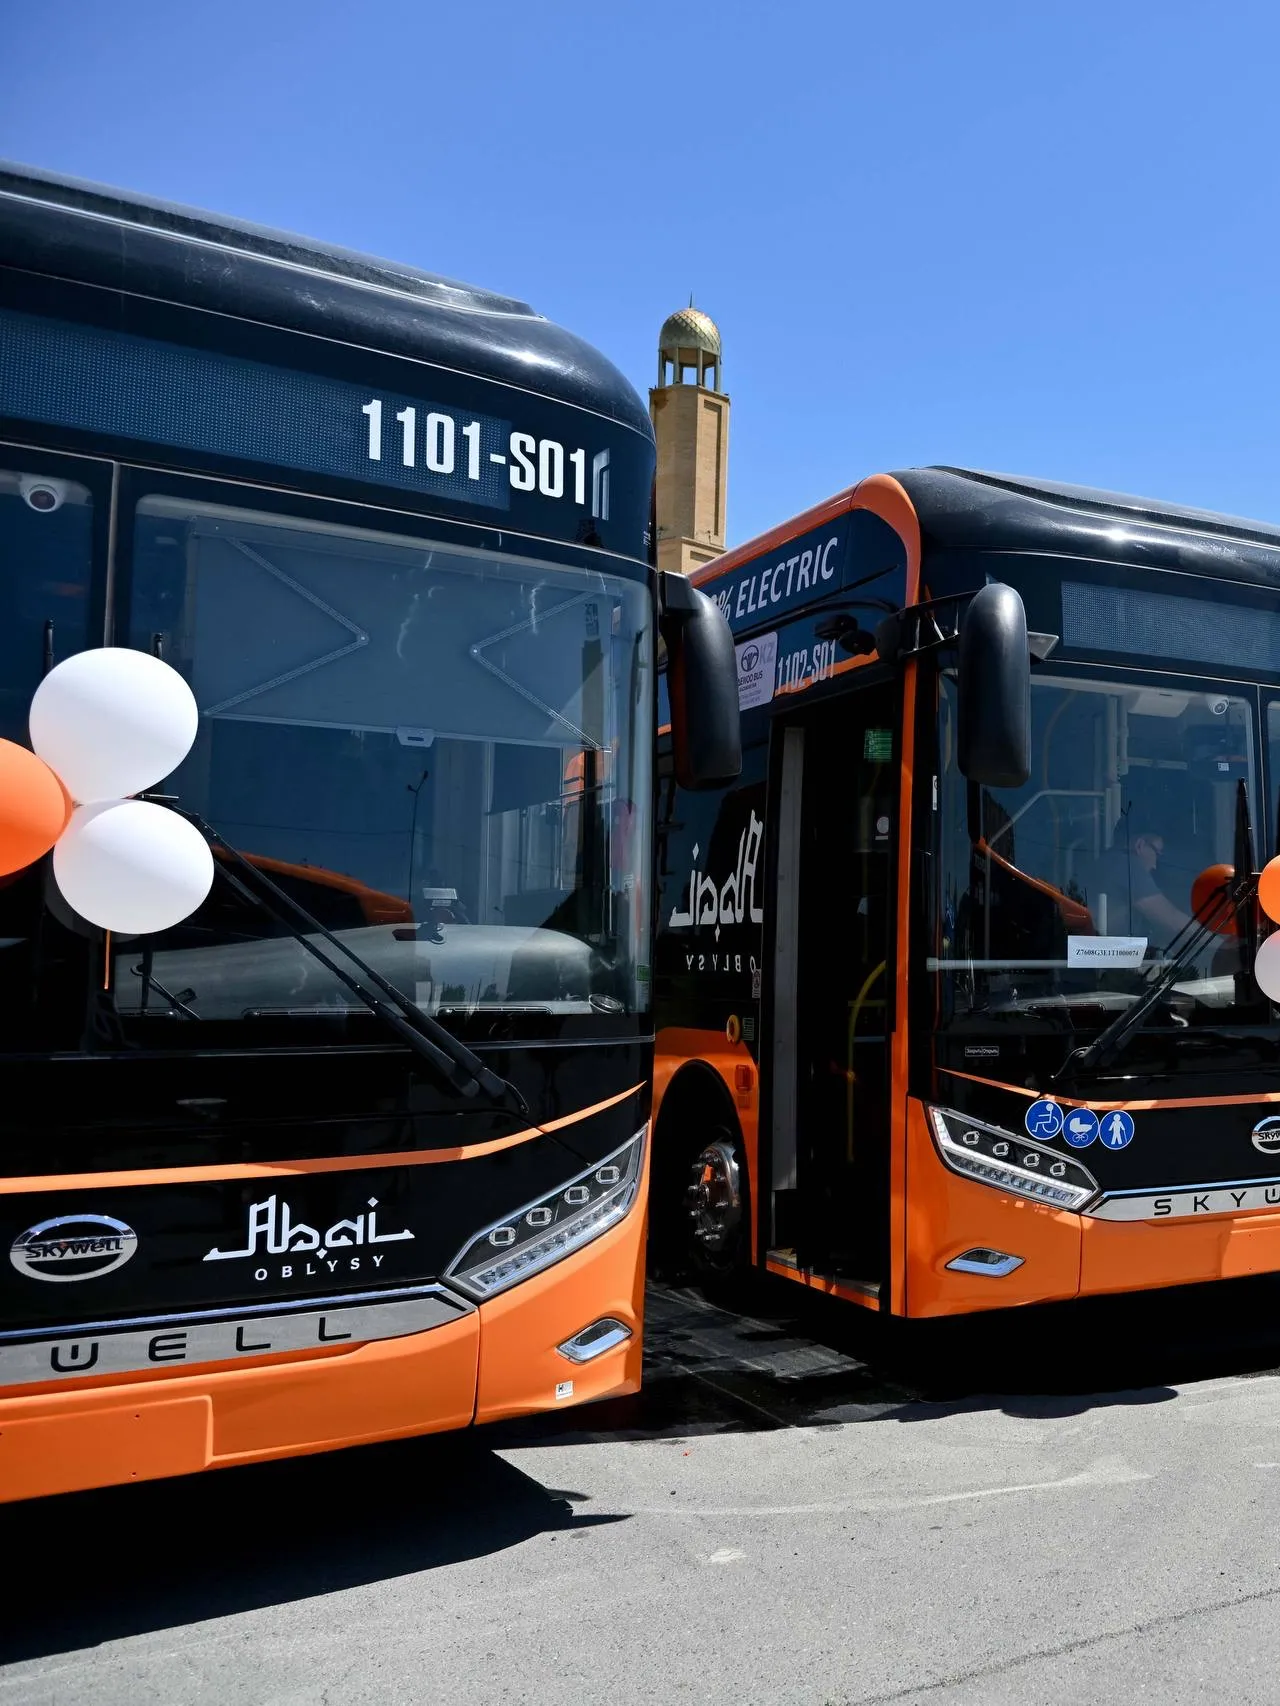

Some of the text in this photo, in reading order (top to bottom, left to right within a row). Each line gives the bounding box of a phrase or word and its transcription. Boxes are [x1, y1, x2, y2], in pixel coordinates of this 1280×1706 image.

[362, 399, 585, 505] 1101-S01
[735, 537, 838, 619] ELECTRIC
[778, 639, 836, 693] 1102-S01
[254, 1254, 386, 1281] OBLYSY
